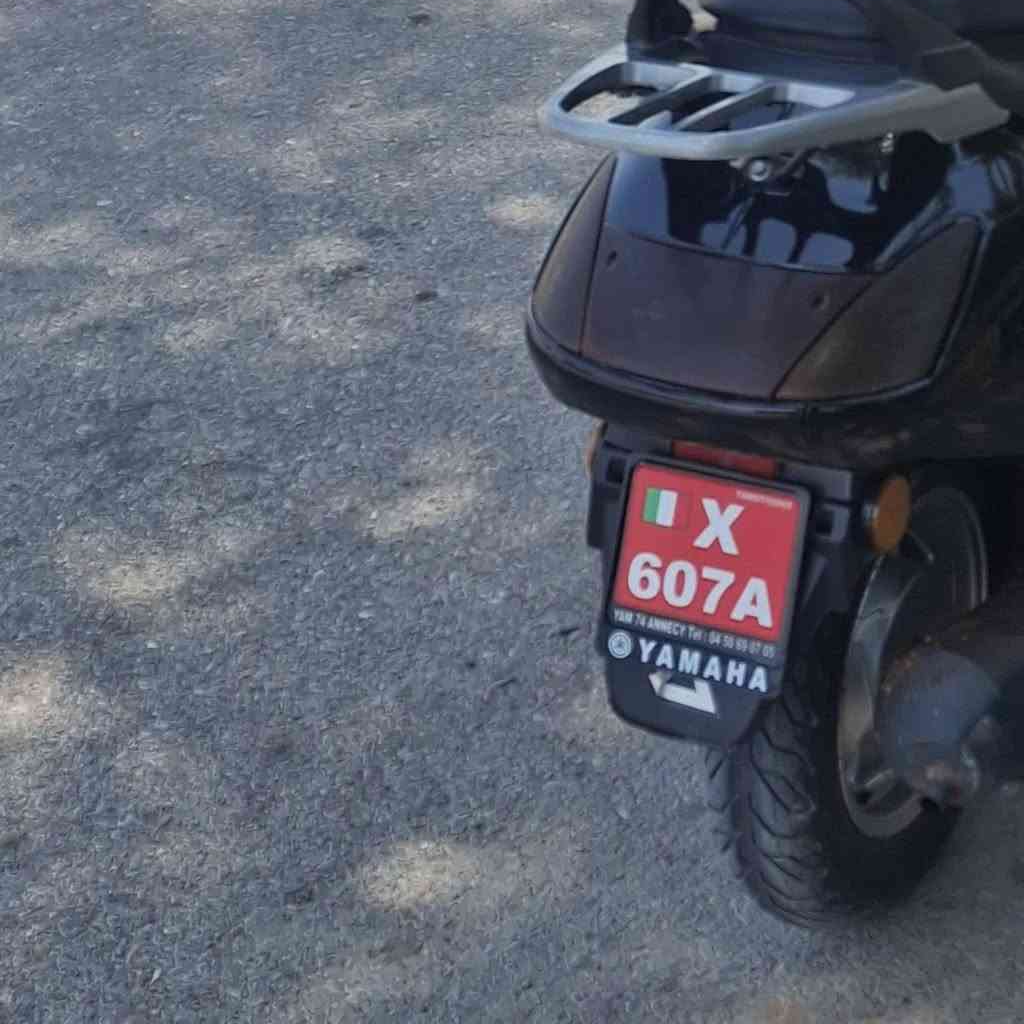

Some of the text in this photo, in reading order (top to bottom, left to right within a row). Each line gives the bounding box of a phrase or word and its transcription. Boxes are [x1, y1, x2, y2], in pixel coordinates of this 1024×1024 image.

[693, 497, 744, 556] X
[627, 552, 773, 629] 607A
[638, 637, 769, 693] YAMAHA
